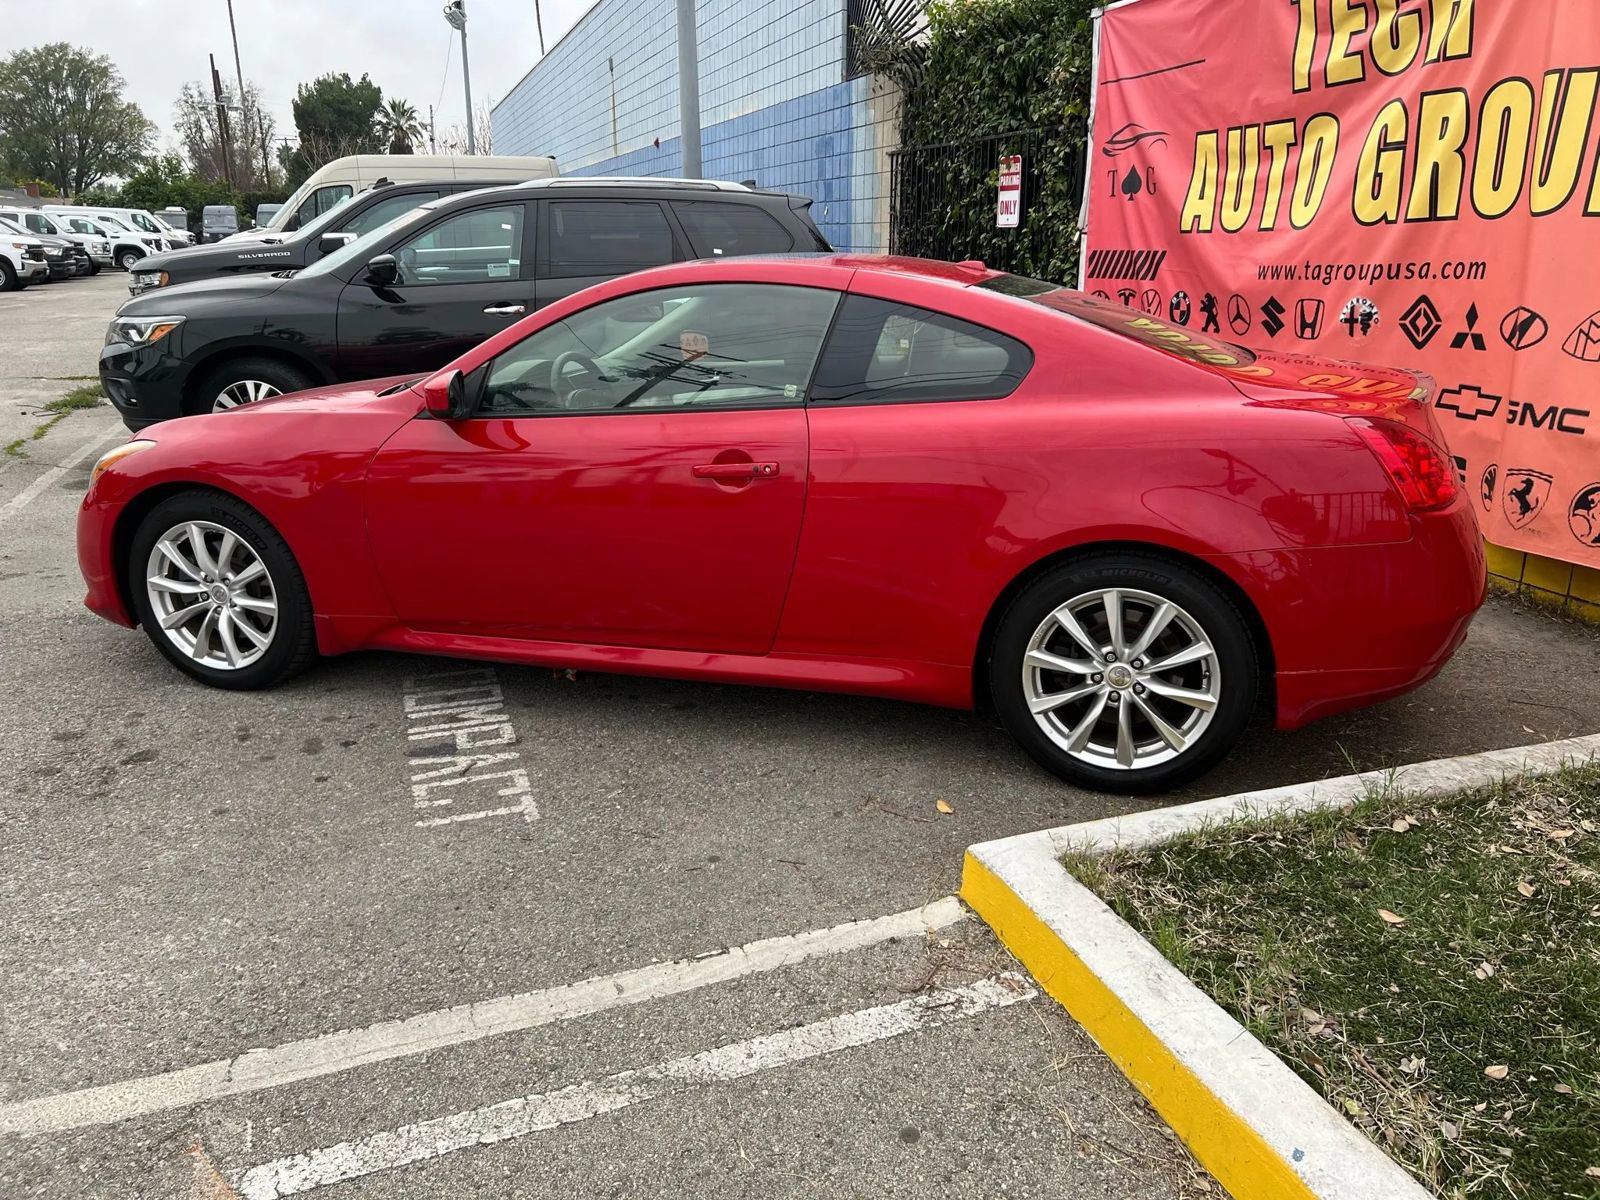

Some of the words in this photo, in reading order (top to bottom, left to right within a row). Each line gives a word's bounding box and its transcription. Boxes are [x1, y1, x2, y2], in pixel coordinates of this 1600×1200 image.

[1180, 112, 1339, 234] AUTO
[1352, 66, 1600, 226] GROU
[1000, 200, 1017, 215] ONLY
[238, 251, 291, 259] SILVERADO
[1257, 259, 1487, 286] www.tagroupusa.com
